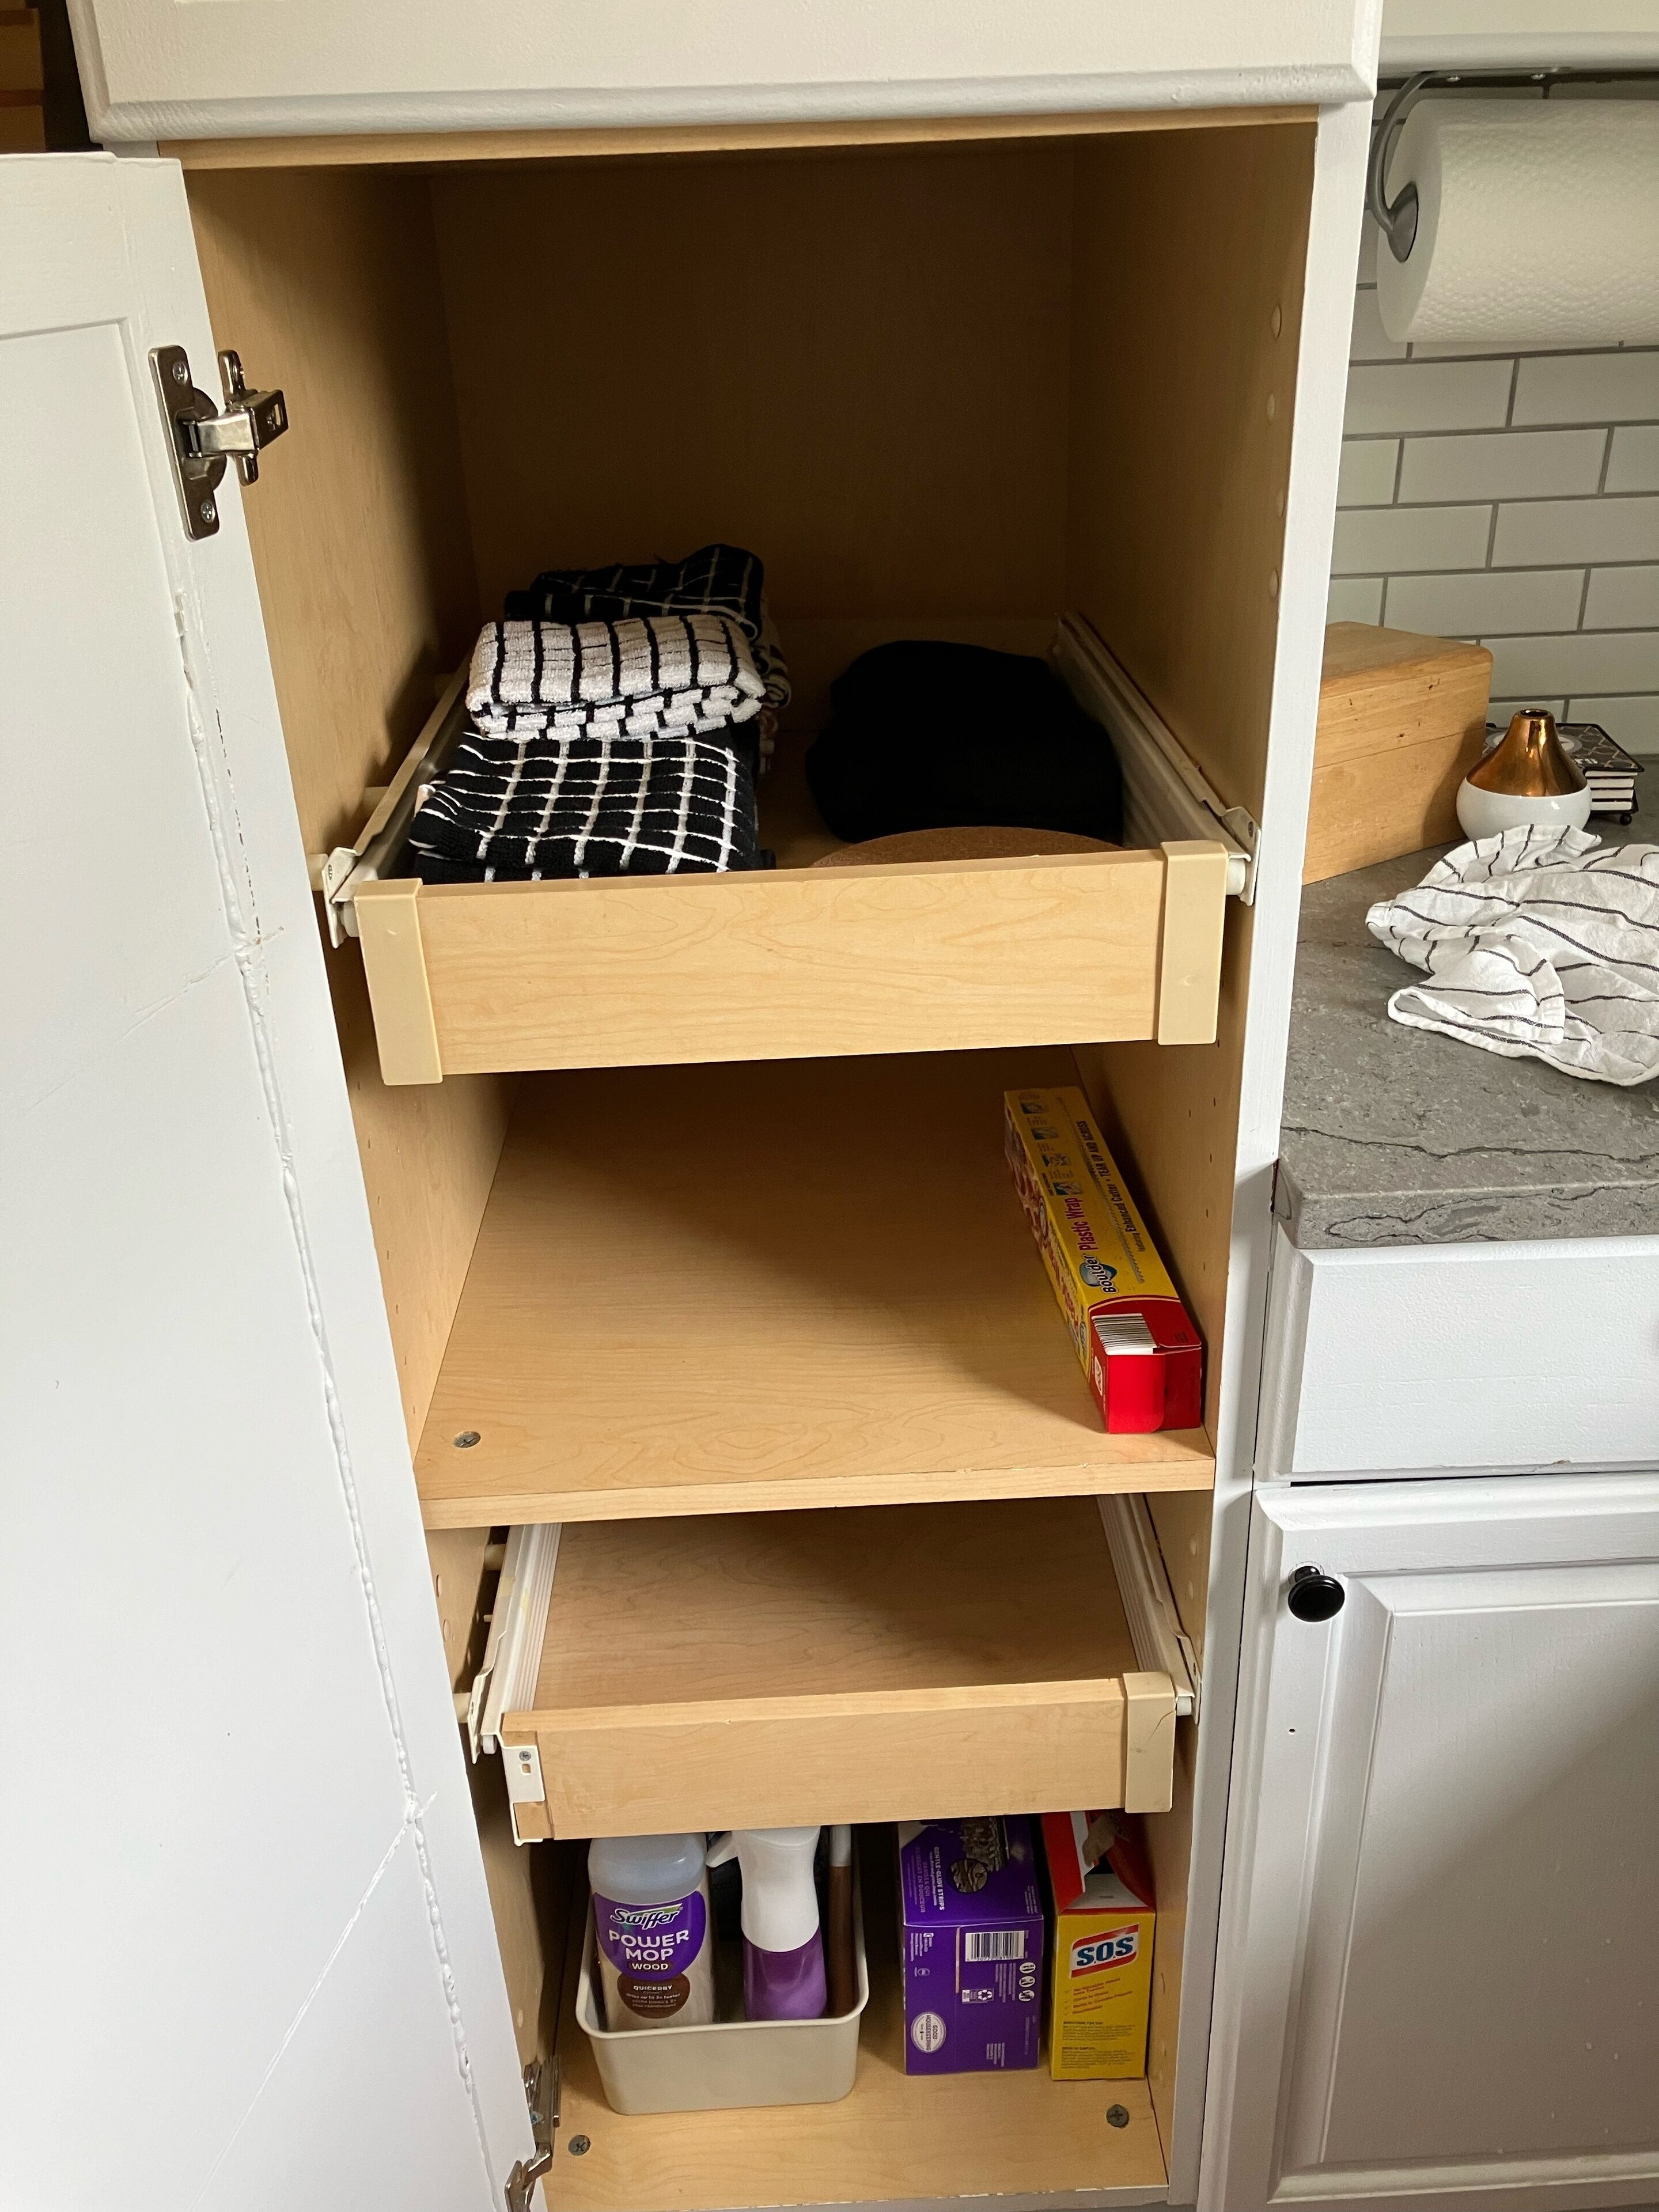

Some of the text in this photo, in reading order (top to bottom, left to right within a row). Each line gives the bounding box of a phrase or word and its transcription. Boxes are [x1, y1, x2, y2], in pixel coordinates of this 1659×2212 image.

[1086, 1142, 1099, 1153] AND
[1091, 1154, 1104, 1162] UP
[1095, 1162, 1109, 1177] TEAR
[1107, 1184, 1123, 1202] Cutter
[1114, 1202, 1137, 1232] Enhanced
[1064, 1197, 1118, 1293] Boulder Plastic Wrap
[611, 1908, 681, 1930] Swiffer
[608, 1929, 690, 1948] POWER
[626, 1948, 673, 1961] MOP
